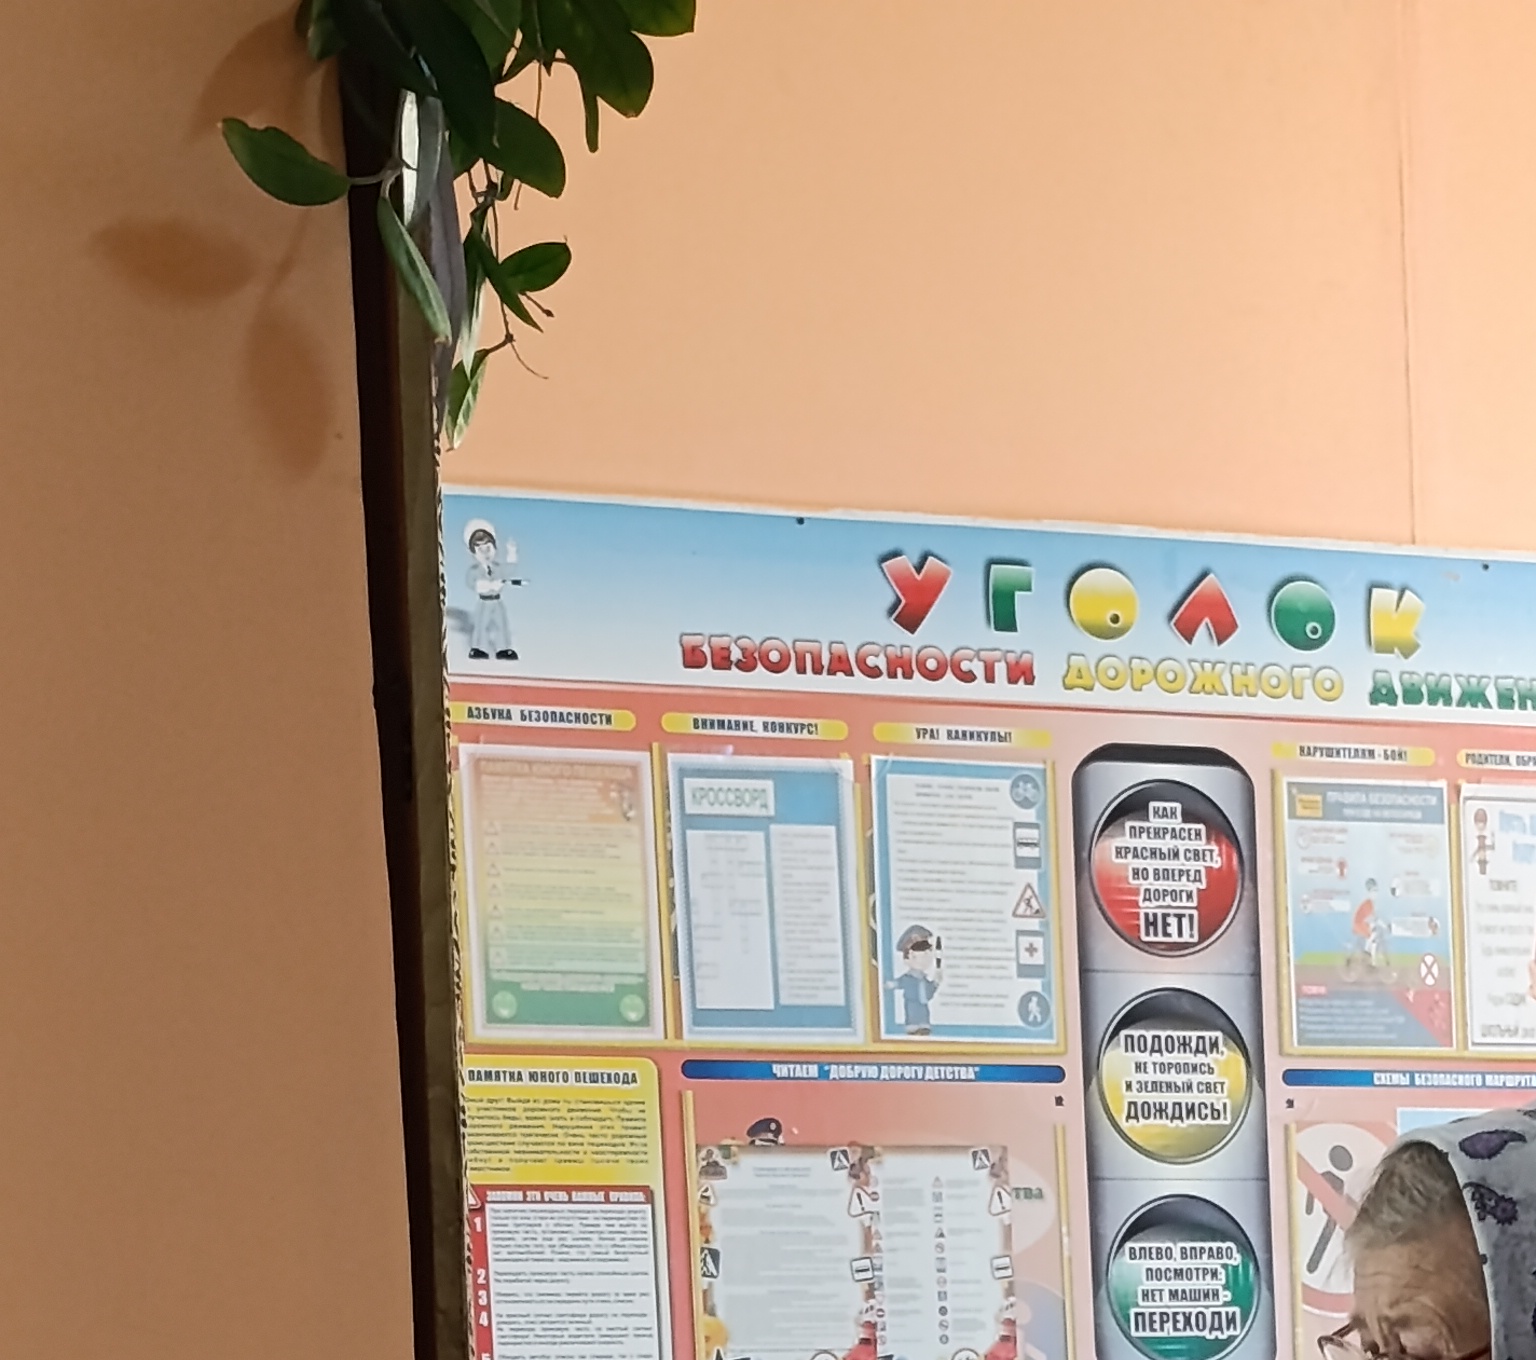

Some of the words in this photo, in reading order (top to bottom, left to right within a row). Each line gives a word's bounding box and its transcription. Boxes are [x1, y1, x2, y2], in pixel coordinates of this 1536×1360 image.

[879, 551, 1426, 659] УГОЛОК
[680, 633, 1035, 685] БЕЗОПАСНОСТИ
[1063, 654, 1343, 701] ДОРОЖНОГО
[467, 706, 512, 721] АЗБУКА
[520, 709, 612, 725] БЕЗОПАСНОСТИ
[762, 721, 818, 735] КОНКУРС!
[915, 728, 939, 740] УРА!
[946, 729, 1012, 743] КАНИКУЛЫ!
[1299, 745, 1376, 759] НАРУШИТЕЛЯМ
[1383, 747, 1407, 761] БОЙ!
[692, 787, 768, 811] КРОССВОРД
[1152, 806, 1178, 819] КАК
[1128, 826, 1203, 841] ПРЕКРАСЕН
[1115, 845, 1180, 861] КРАСНЫЙ
[1184, 848, 1219, 864] СВЕТ,
[1132, 867, 1149, 881] НО
[1153, 867, 1203, 883] ВПЕРЕД
[1142, 888, 1194, 903] ДОРОГИ
[1144, 912, 1195, 938] НЕТ!
[1124, 1034, 1225, 1057] ПОДОЖДИ,
[772, 1063, 818, 1078] ЧИТАЕМ
[879, 1065, 924, 1081] ДОРОГУ
[1135, 1062, 1149, 1074] НЕ
[1152, 1062, 1215, 1075] ТОРОПИСЬ
[468, 1069, 523, 1082] ПАМЯТКА
[528, 1070, 569, 1083] ЮНОГО
[574, 1071, 638, 1085] ПЕШЕХОДА
[1373, 1072, 1410, 1085] СХЕМЫ
[1414, 1073, 1482, 1086] БЕЗОПАСНОГО
[1125, 1081, 1132, 1092] И
[1136, 1079, 1194, 1093] ЗЕЛЕНЫЙ
[1197, 1081, 1226, 1094] СВЕТ
[1125, 1101, 1228, 1123] ДОЖДИСЬ!
[473, 1217, 482, 1232] 1
[1128, 1246, 1177, 1262] ВЛЕВО,
[1180, 1246, 1237, 1261] ВПРАВО,
[477, 1268, 486, 1284] 2
[1145, 1267, 1222, 1282] ПОСМОТРИ:
[478, 1290, 487, 1306] 3
[1141, 1289, 1164, 1302] НЕТ
[1168, 1288, 1220, 1302] МАШИН
[479, 1311, 488, 1327] 4
[1134, 1311, 1237, 1335] ПЕРЕХОДИ
